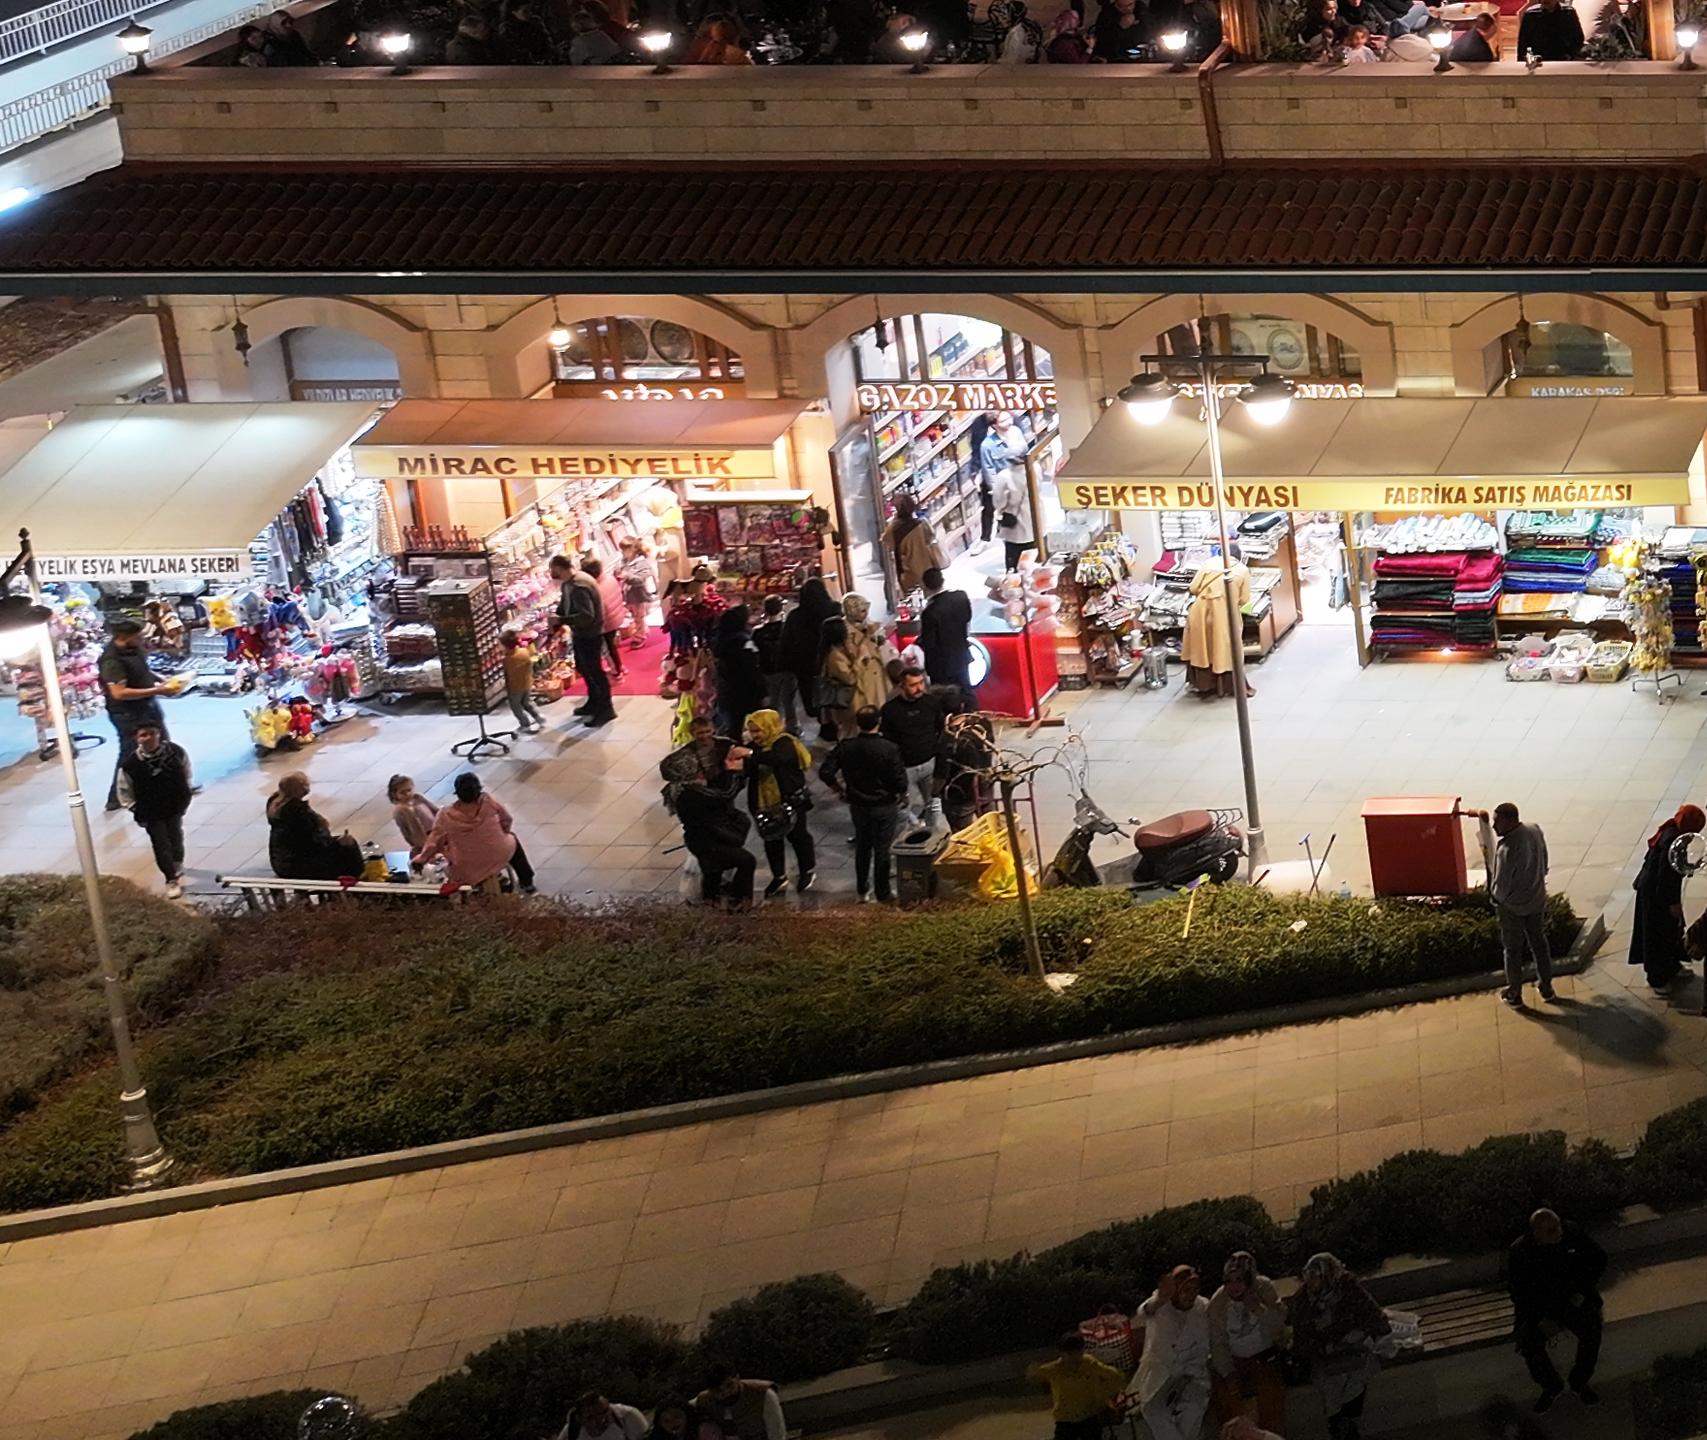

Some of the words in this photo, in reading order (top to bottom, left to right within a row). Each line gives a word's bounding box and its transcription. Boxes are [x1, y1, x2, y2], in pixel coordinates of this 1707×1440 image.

[857, 384, 957, 410] GAZOZ
[958, 383, 1057, 410] MARKE
[398, 453, 519, 475] MİRAC
[531, 452, 734, 475] HEDİYELİK
[1075, 485, 1168, 509] ŞEKER
[1177, 482, 1299, 508] DÜNYASI
[1384, 483, 1467, 505] FABRİKA
[1473, 485, 1526, 506] SATIŞ
[1532, 481, 1633, 503] MAĞAZASI
[82, 559, 116, 575] EŞYA
[120, 557, 187, 575] MEVLANA
[191, 554, 240, 575] ŞEKERİ
